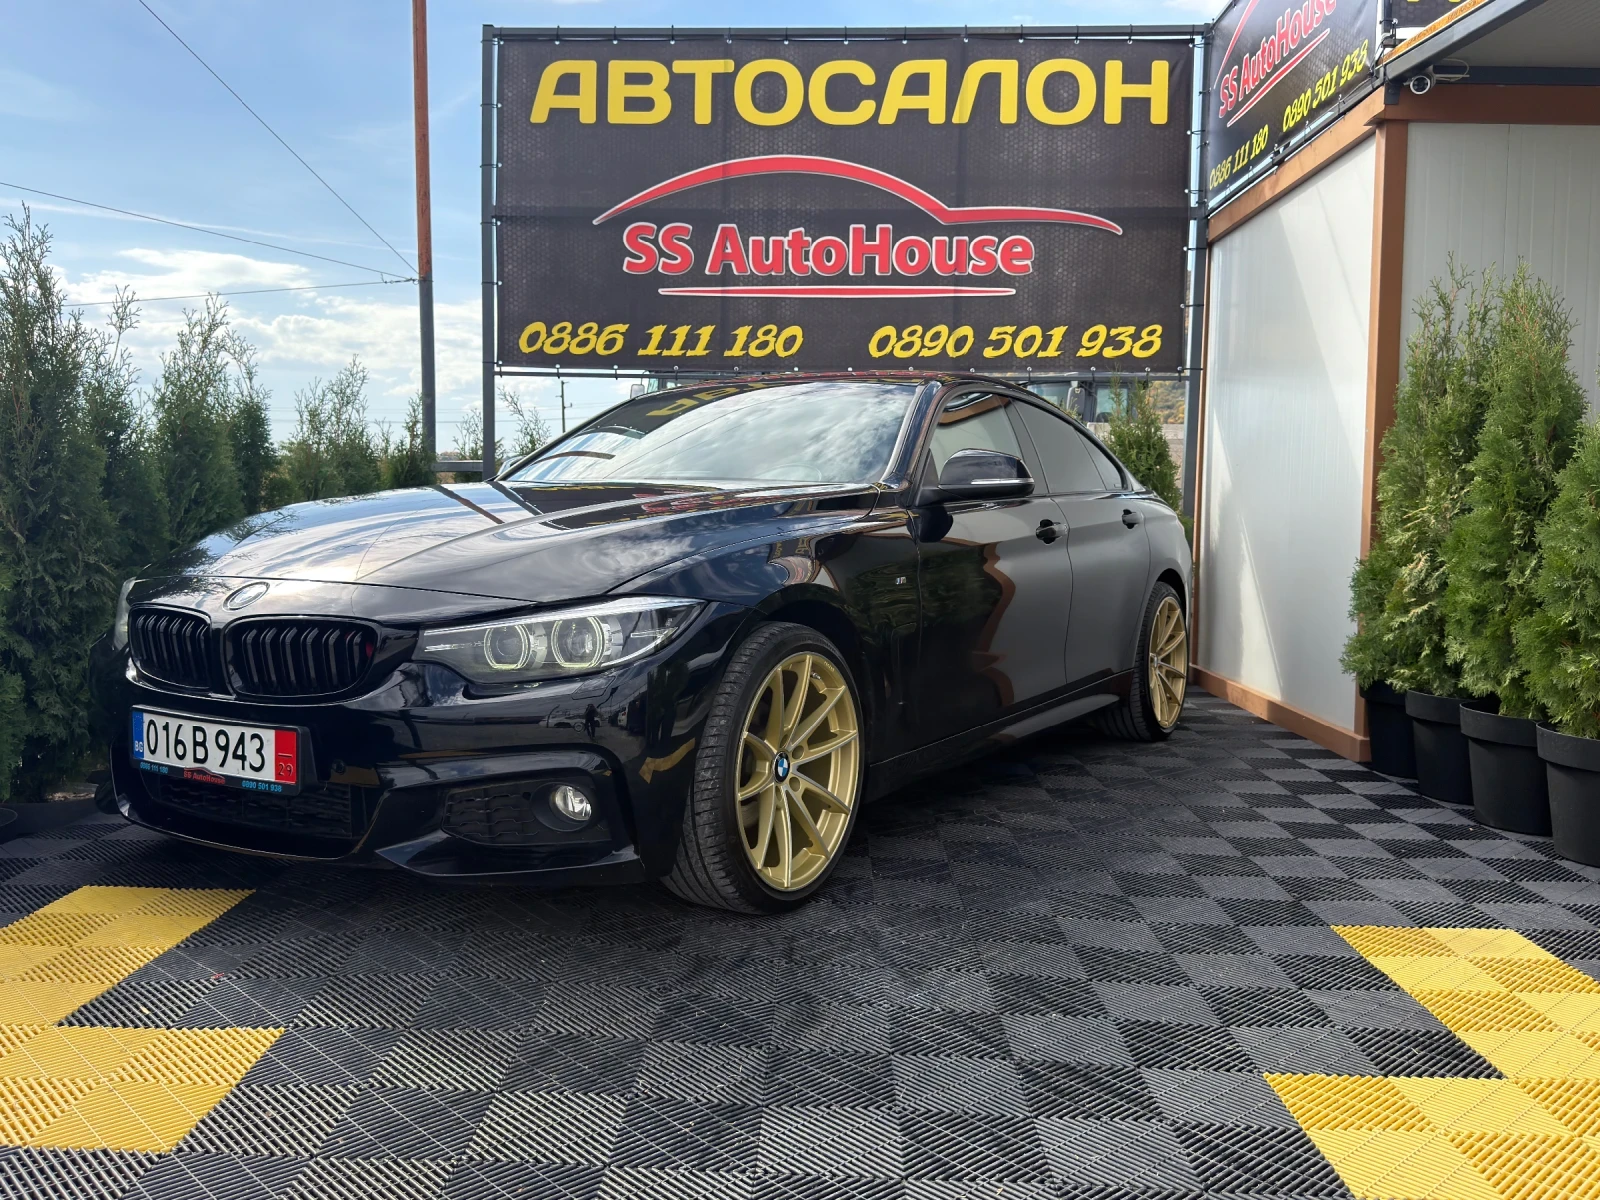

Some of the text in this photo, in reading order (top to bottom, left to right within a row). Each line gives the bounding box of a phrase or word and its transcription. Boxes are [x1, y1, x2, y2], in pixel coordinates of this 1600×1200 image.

[529, 58, 1170, 127] АВТОСАЛОН
[1218, 65, 1239, 119] SS
[1282, 39, 1369, 132] 0890 501 938
[1209, 124, 1269, 190] 0886 111 180
[622, 222, 1035, 278] SS AutoHouse
[518, 321, 804, 358] 0886 111 180
[868, 324, 1163, 358] 0890 501 938
[134, 740, 144, 753] BG
[278, 762, 294, 777] 29
